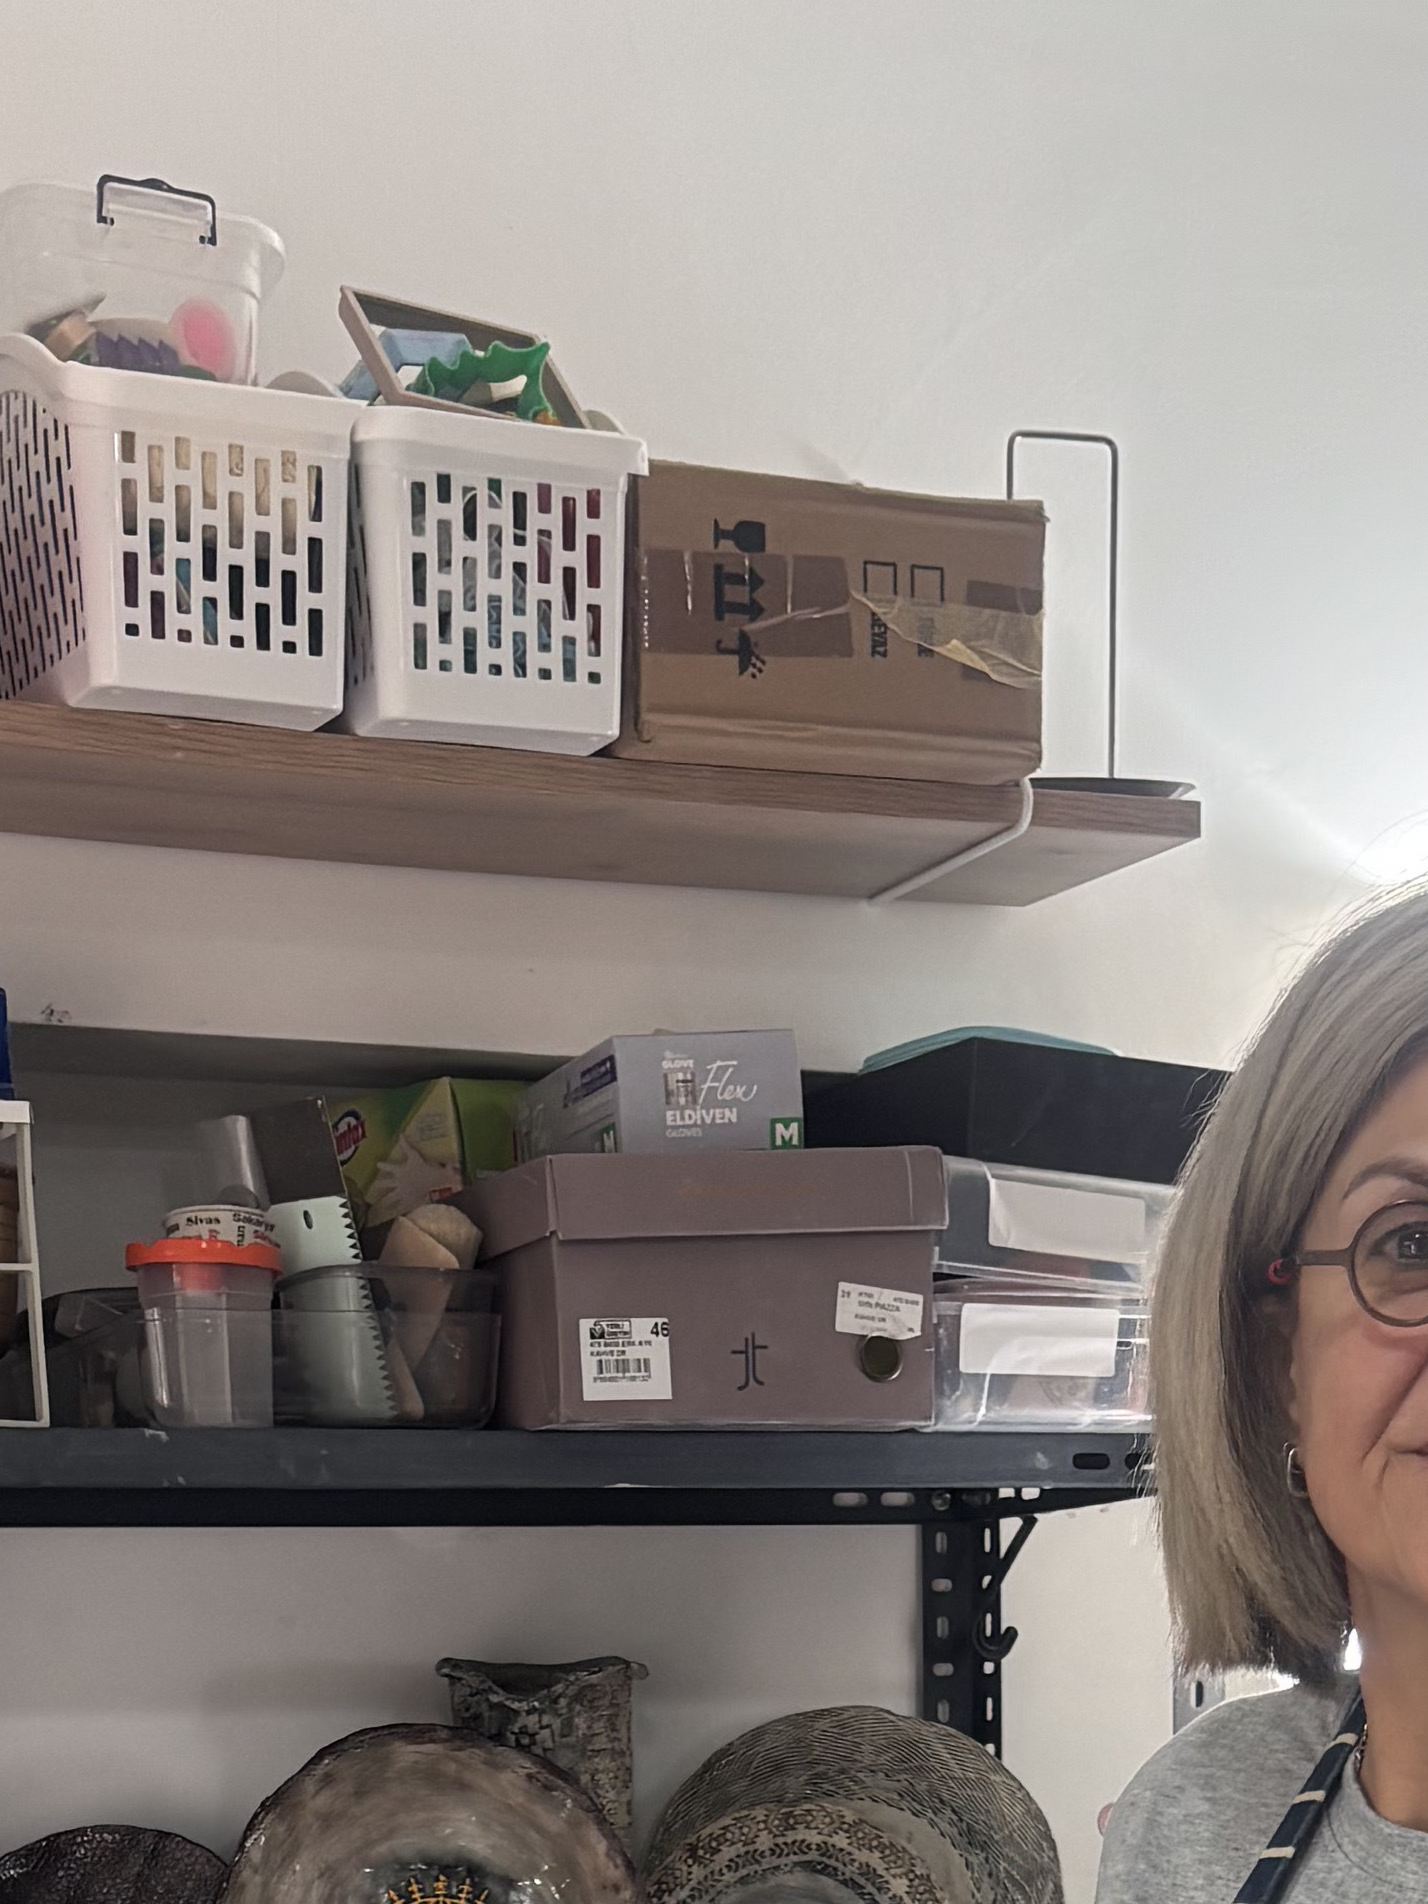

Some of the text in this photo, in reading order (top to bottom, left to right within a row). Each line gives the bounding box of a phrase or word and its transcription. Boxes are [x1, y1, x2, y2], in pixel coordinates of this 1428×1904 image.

[698, 1060, 757, 1104] Flex
[665, 1104, 738, 1126] ELDİVEN
[775, 1122, 799, 1146] M
[650, 1321, 670, 1338] 46
